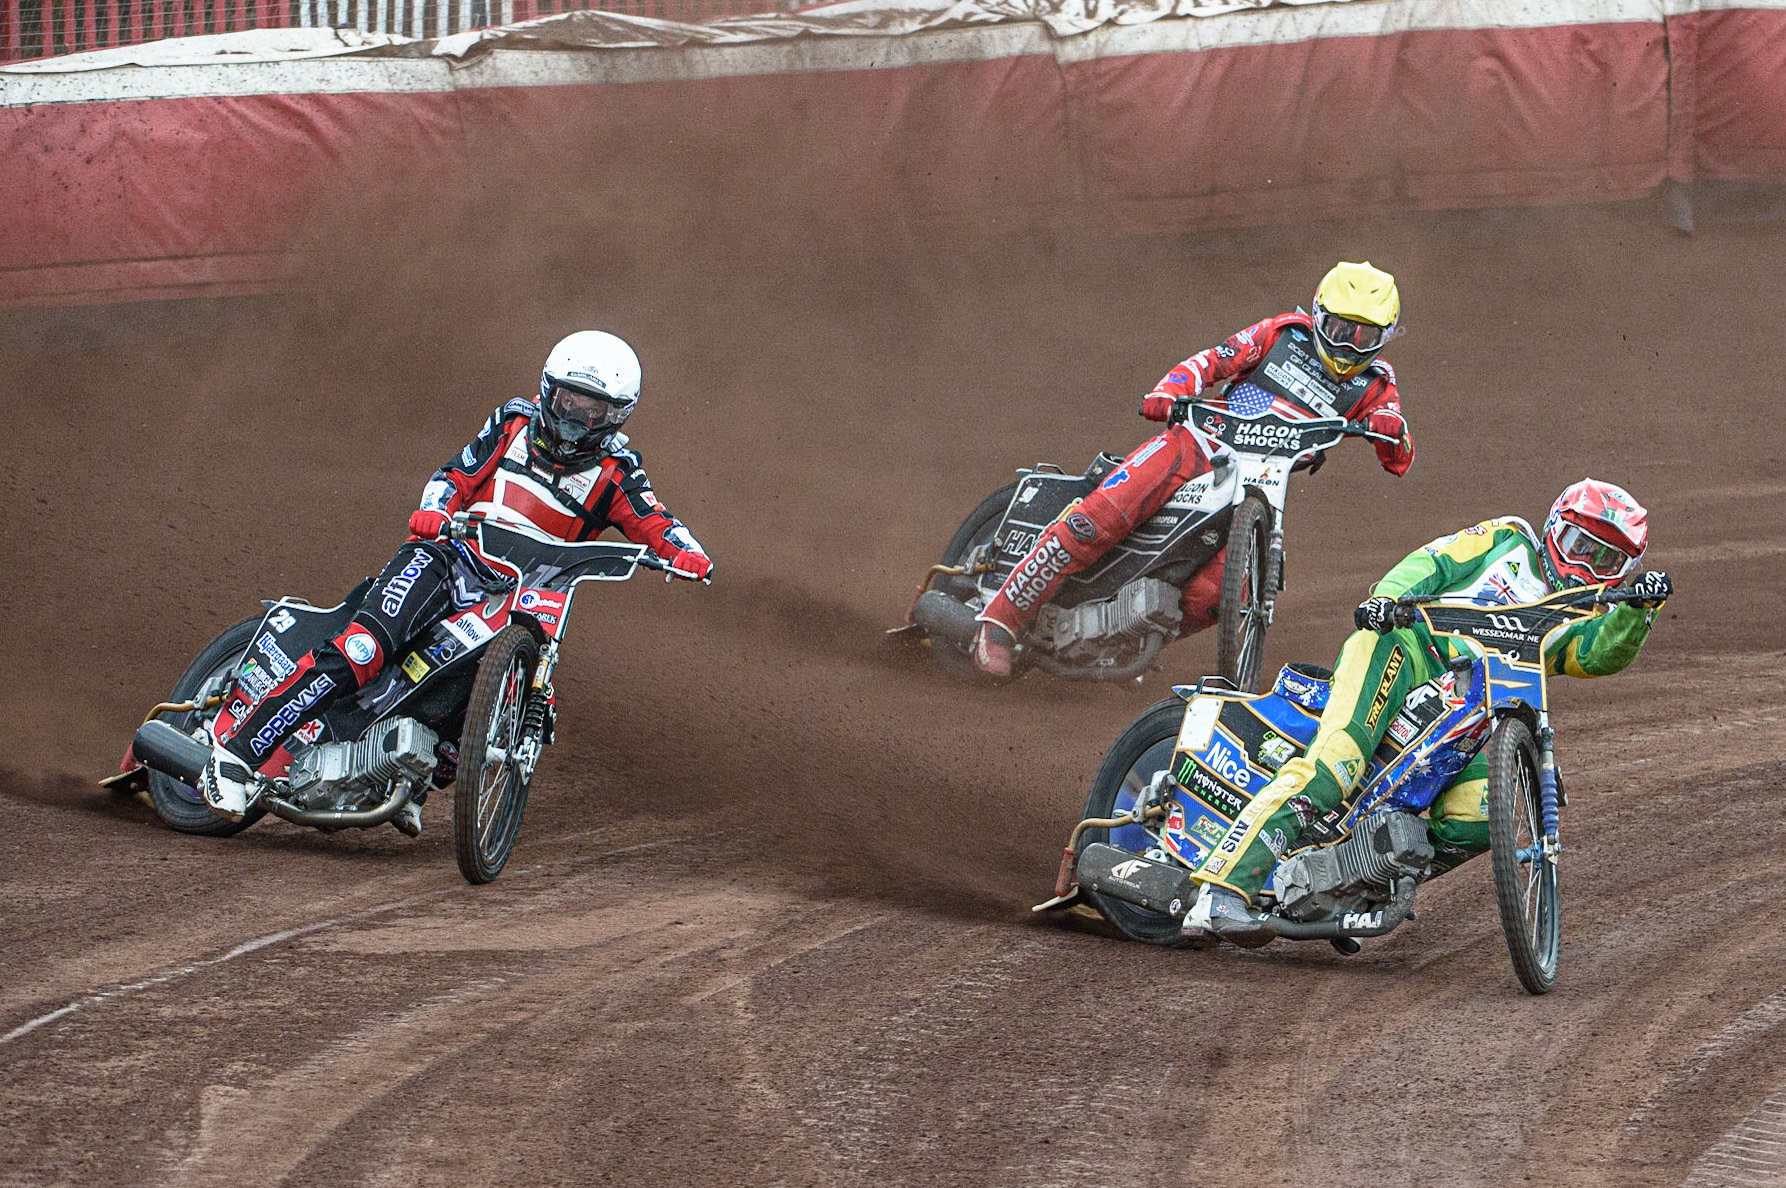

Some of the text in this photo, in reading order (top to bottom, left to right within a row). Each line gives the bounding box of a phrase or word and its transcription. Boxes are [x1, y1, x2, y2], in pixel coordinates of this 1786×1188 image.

[1288, 342, 1310, 361] 2021
[1289, 354, 1303, 367] GP
[1234, 434, 1301, 450] SHOCKS
[1236, 423, 1304, 439] HAGON
[1178, 483, 1209, 494] AGON
[1243, 477, 1280, 486] HAGON
[1171, 494, 1203, 504] HOCKS
[1003, 529, 1034, 557] HA
[1005, 536, 1061, 601] HAGON
[1015, 549, 1071, 611] SHOCKS
[382, 547, 434, 618] alflow
[268, 609, 297, 634] 29
[456, 618, 482, 642] alflow
[1472, 627, 1540, 643] WESSEXMARNE
[257, 633, 294, 673] Kjærgaar
[351, 639, 371, 658] ATPI
[1368, 650, 1403, 727] TRU PLANT
[1390, 718, 1412, 740] astrol
[1260, 738, 1296, 763] 43
[1204, 740, 1251, 788] Nice
[1193, 770, 1243, 811] MONSTER
[1193, 785, 1235, 816] ENERGY
